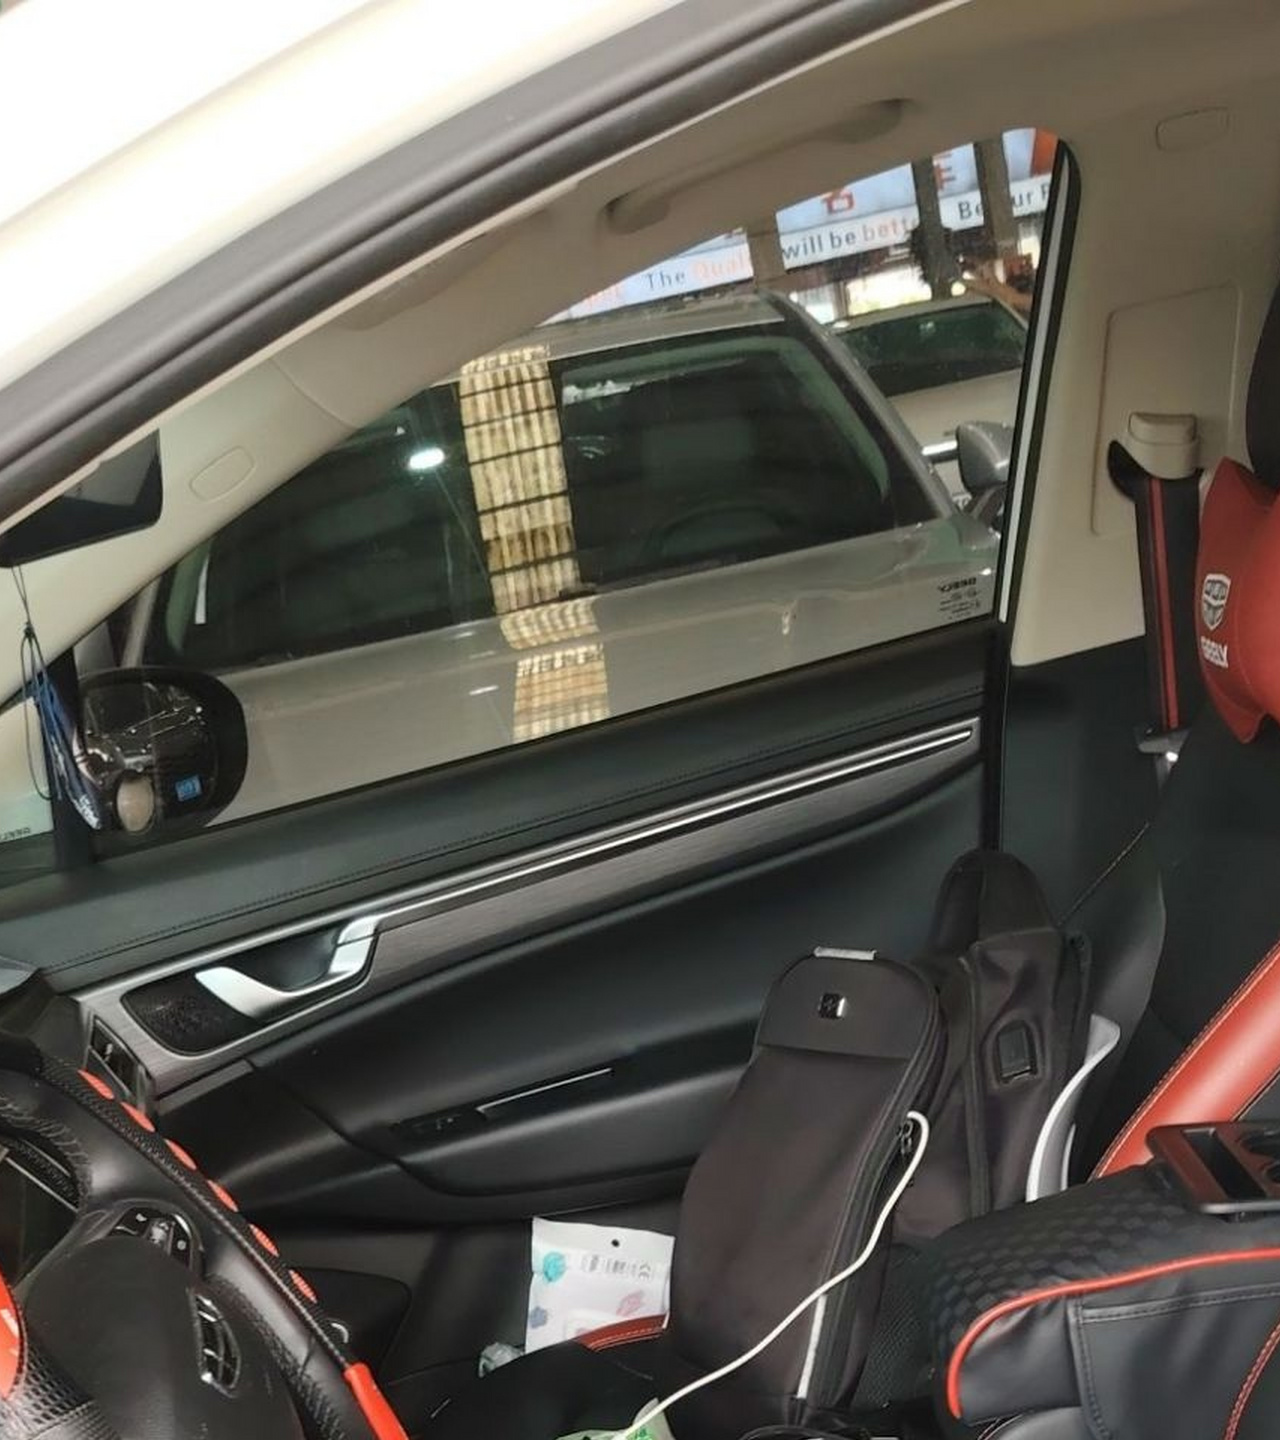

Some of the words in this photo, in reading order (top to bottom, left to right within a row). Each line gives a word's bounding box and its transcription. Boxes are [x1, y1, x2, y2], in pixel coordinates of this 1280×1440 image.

[644, 270, 686, 292] The
[782, 235, 823, 260] will
[829, 231, 857, 249] be
